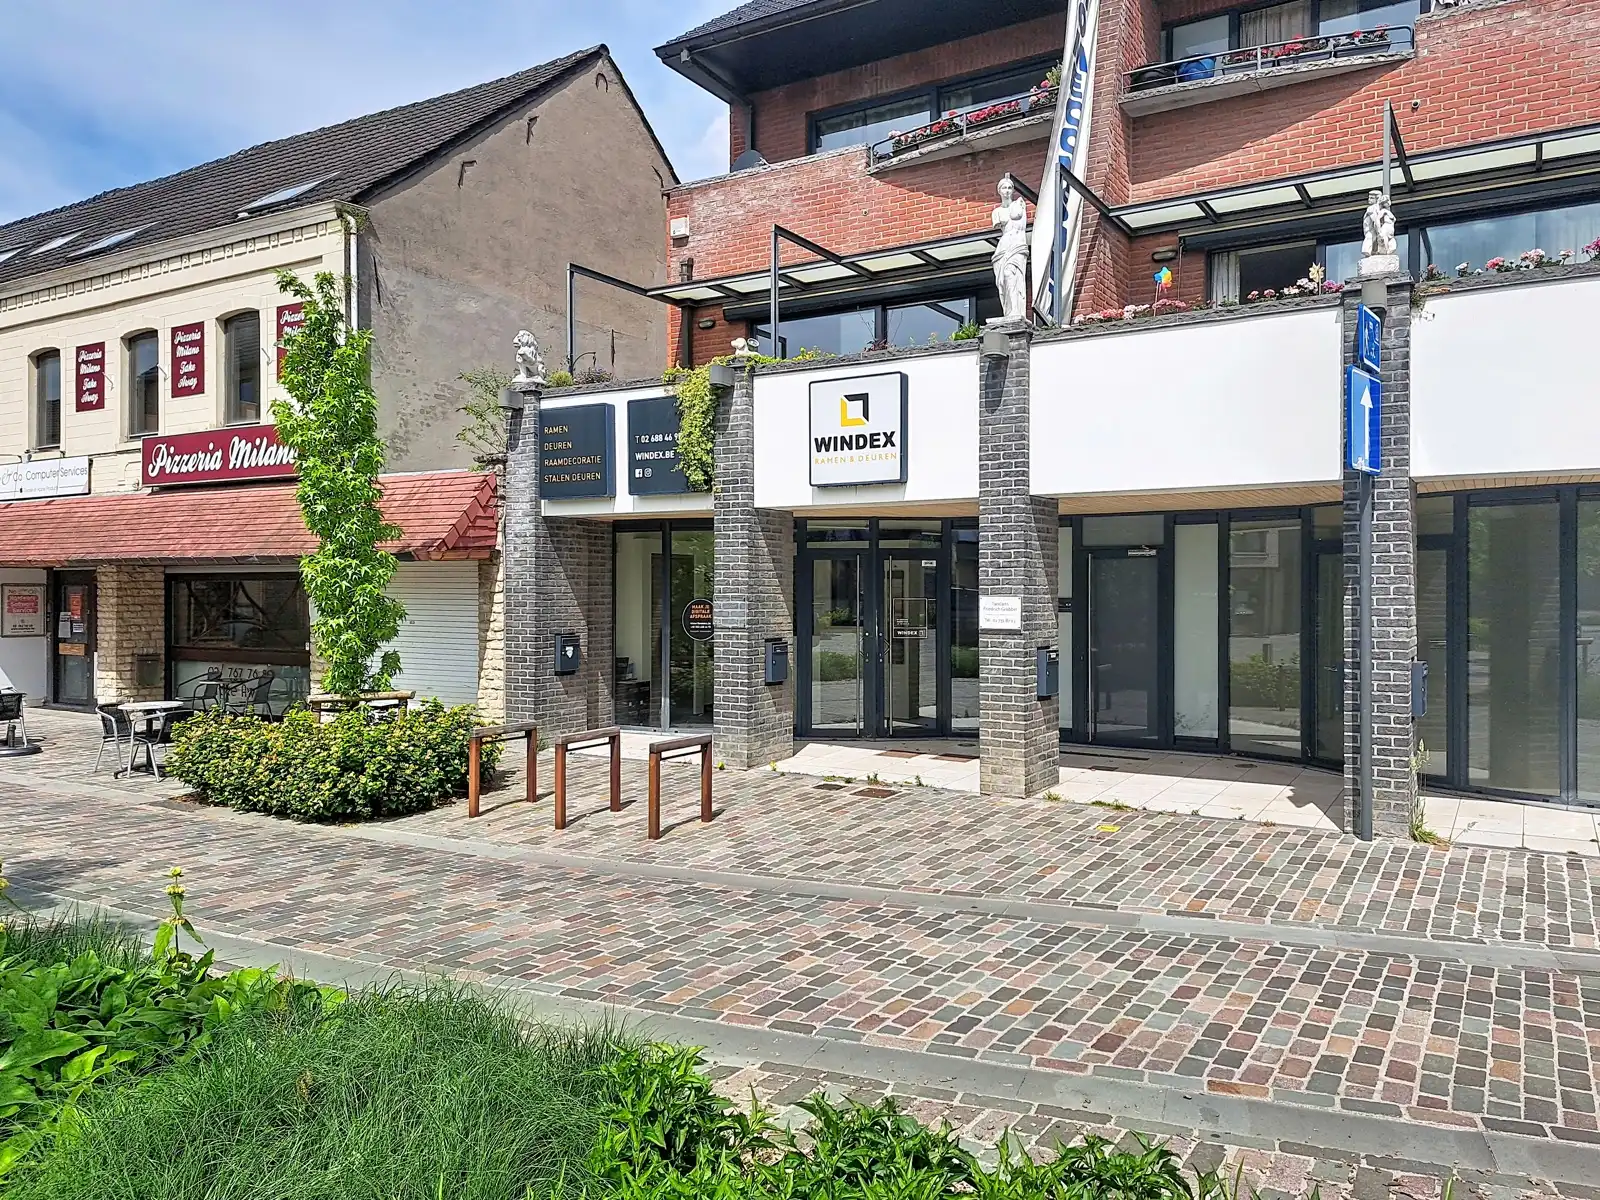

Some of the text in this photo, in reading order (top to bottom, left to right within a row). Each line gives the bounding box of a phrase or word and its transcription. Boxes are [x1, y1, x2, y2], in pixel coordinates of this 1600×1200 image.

[174, 329, 201, 345] Pizzeria
[78, 348, 102, 363] Pizzeria
[176, 345, 200, 358] Milano
[80, 363, 101, 375] Milano
[180, 361, 196, 374] Take
[82, 378, 97, 390] Take
[178, 375, 198, 390] Away
[80, 391, 98, 405] Away
[544, 426, 568, 434] RAMEN
[634, 435, 640, 444] T
[640, 435, 650, 444] 02
[650, 434, 663, 442] 688
[664, 432, 673, 442] 46
[814, 431, 896, 453] WINDEX
[544, 442, 572, 451] DEUREN
[148, 442, 223, 477] Pizzeria
[544, 456, 602, 466] RAAMDECORATIE
[634, 450, 675, 460] WINDEX.BE
[814, 457, 846, 465] RAMEN
[858, 452, 897, 462] DEUREN
[26, 469, 60, 481] Computer
[60, 466, 88, 478] Services
[544, 472, 601, 483] STALEN DEUREN
[228, 668, 244, 678] 767
[248, 668, 258, 678] 76
